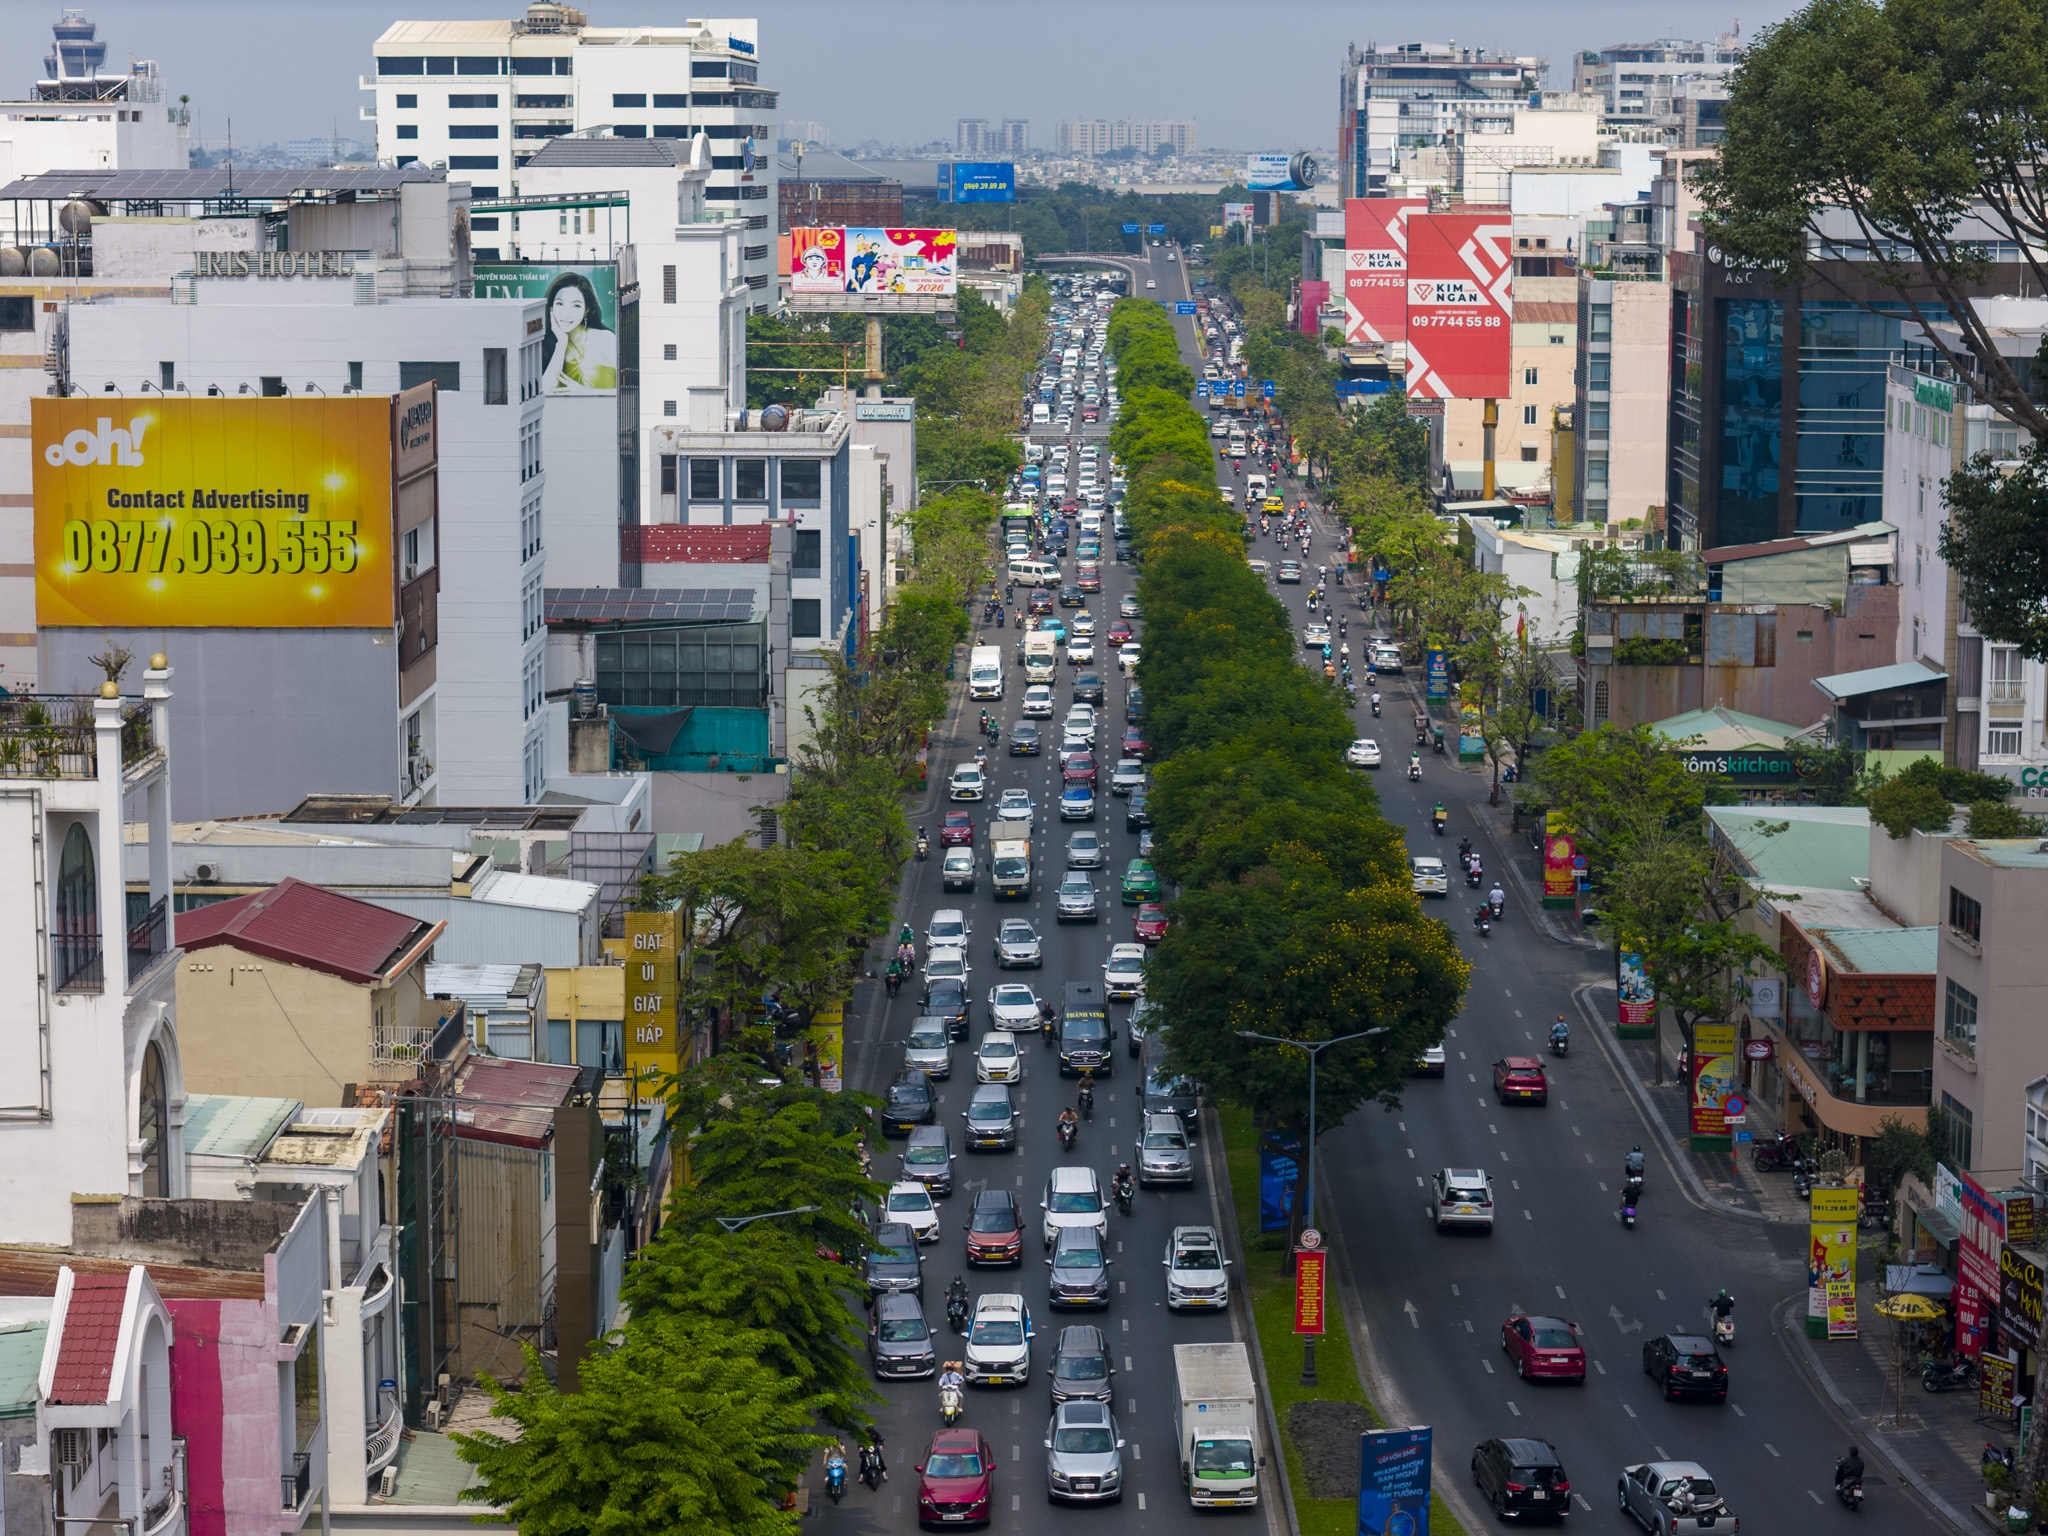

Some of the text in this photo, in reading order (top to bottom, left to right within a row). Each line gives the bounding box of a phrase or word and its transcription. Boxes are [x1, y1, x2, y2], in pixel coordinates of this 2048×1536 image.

[194, 250, 354, 277] IRIS HOTEL
[1369, 260, 1402, 268] NGAN
[499, 273, 518, 281] KHOA
[1725, 272, 1733, 283] A
[1746, 272, 1753, 284] C
[916, 284, 944, 292] 2026
[1436, 284, 1463, 293] KIM
[1436, 293, 1477, 302] NGAN
[1412, 316, 1428, 327] 09
[1466, 316, 1482, 327] 55
[1484, 316, 1501, 327] 88
[862, 408, 905, 417] OK MART
[107, 488, 309, 514] Contact Advertising
[63, 519, 358, 574] 0877.039.555
[633, 930, 662, 953] GIẶT
[642, 960, 655, 981] ỦI
[633, 992, 662, 1016] GIẶT
[636, 1019, 663, 1043] HẤP
[1961, 1310, 1975, 1326] MÁY
[1373, 1465, 1401, 1478] NHANH
